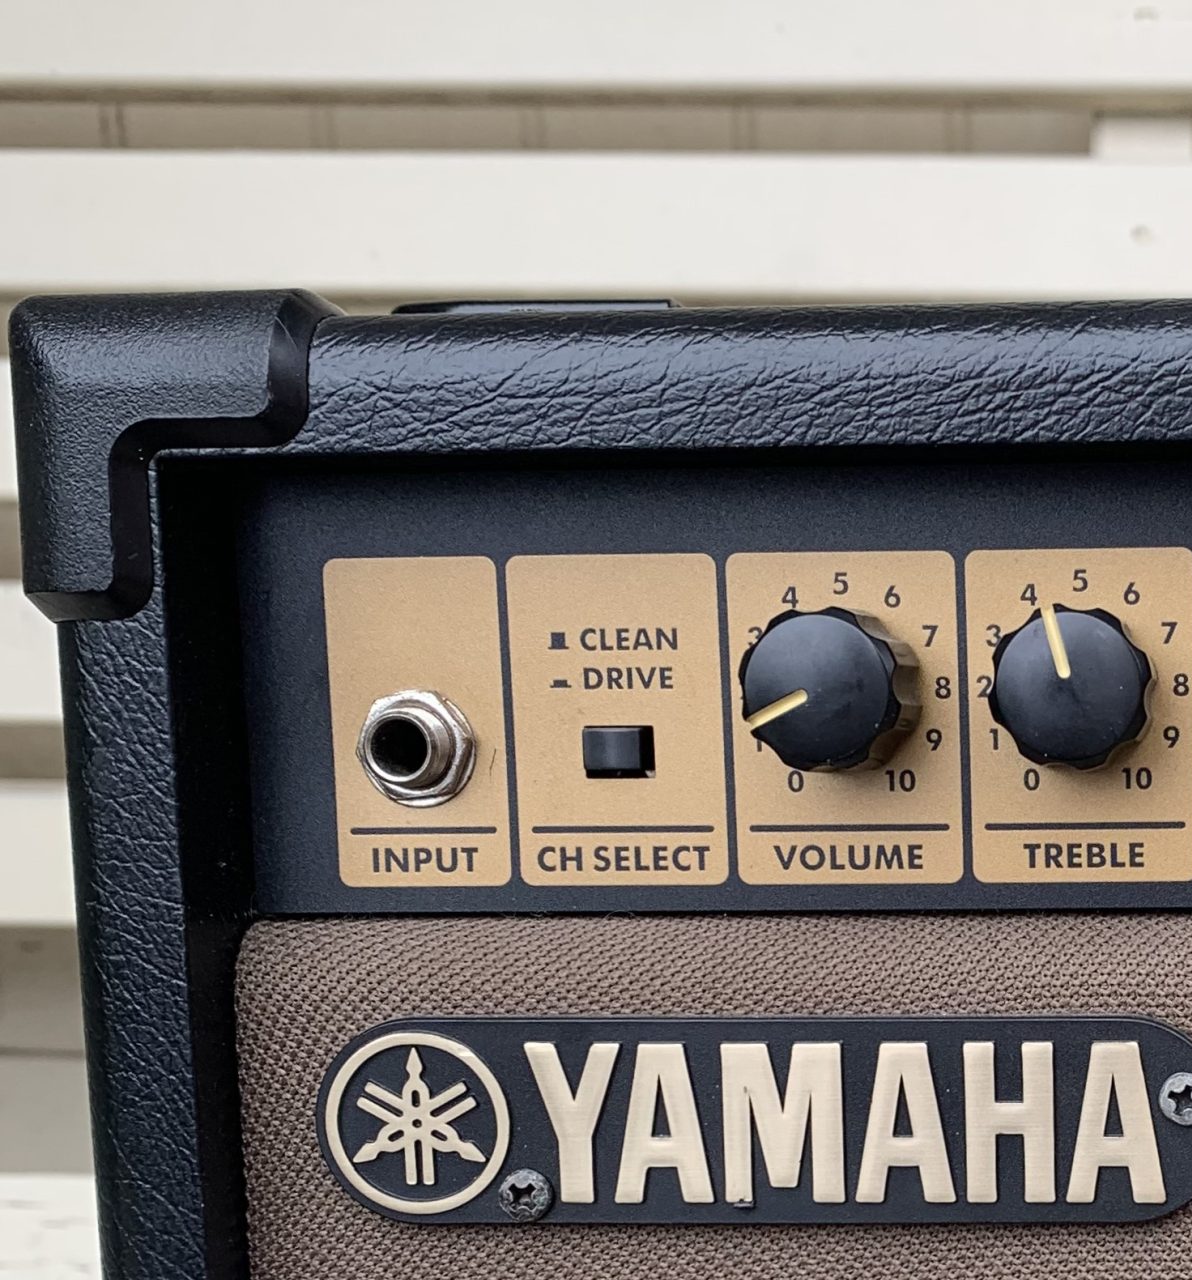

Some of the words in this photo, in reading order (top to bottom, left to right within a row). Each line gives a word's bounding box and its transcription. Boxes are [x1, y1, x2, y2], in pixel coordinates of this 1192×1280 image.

[833, 572, 848, 595] 5
[1072, 569, 1088, 592] 5
[782, 586, 799, 608] 4
[884, 586, 900, 608] 6
[1020, 584, 1037, 606] 4
[1124, 582, 1140, 605] 6
[579, 627, 678, 651] CLEAN
[922, 625, 939, 647] 7
[986, 625, 1001, 647] 3
[1161, 622, 1178, 644] 7
[583, 667, 674, 690] DRIVE
[935, 677, 951, 700] 8
[977, 676, 992, 698] 2
[1173, 673, 1189, 696] 8
[926, 729, 942, 751] 9
[989, 729, 999, 750] 1
[1163, 726, 1179, 748] 9
[788, 771, 804, 793] 0
[885, 770, 916, 792] 10
[1024, 769, 1040, 790] 0
[1122, 768, 1152, 789] 10
[372, 847, 478, 873] INPUT
[537, 847, 583, 871] CH
[594, 845, 710, 871] SELECT
[773, 845, 923, 870] VOLUME
[1023, 843, 1145, 868] TREBLE
[523, 1041, 1168, 1204] YAMAHA
